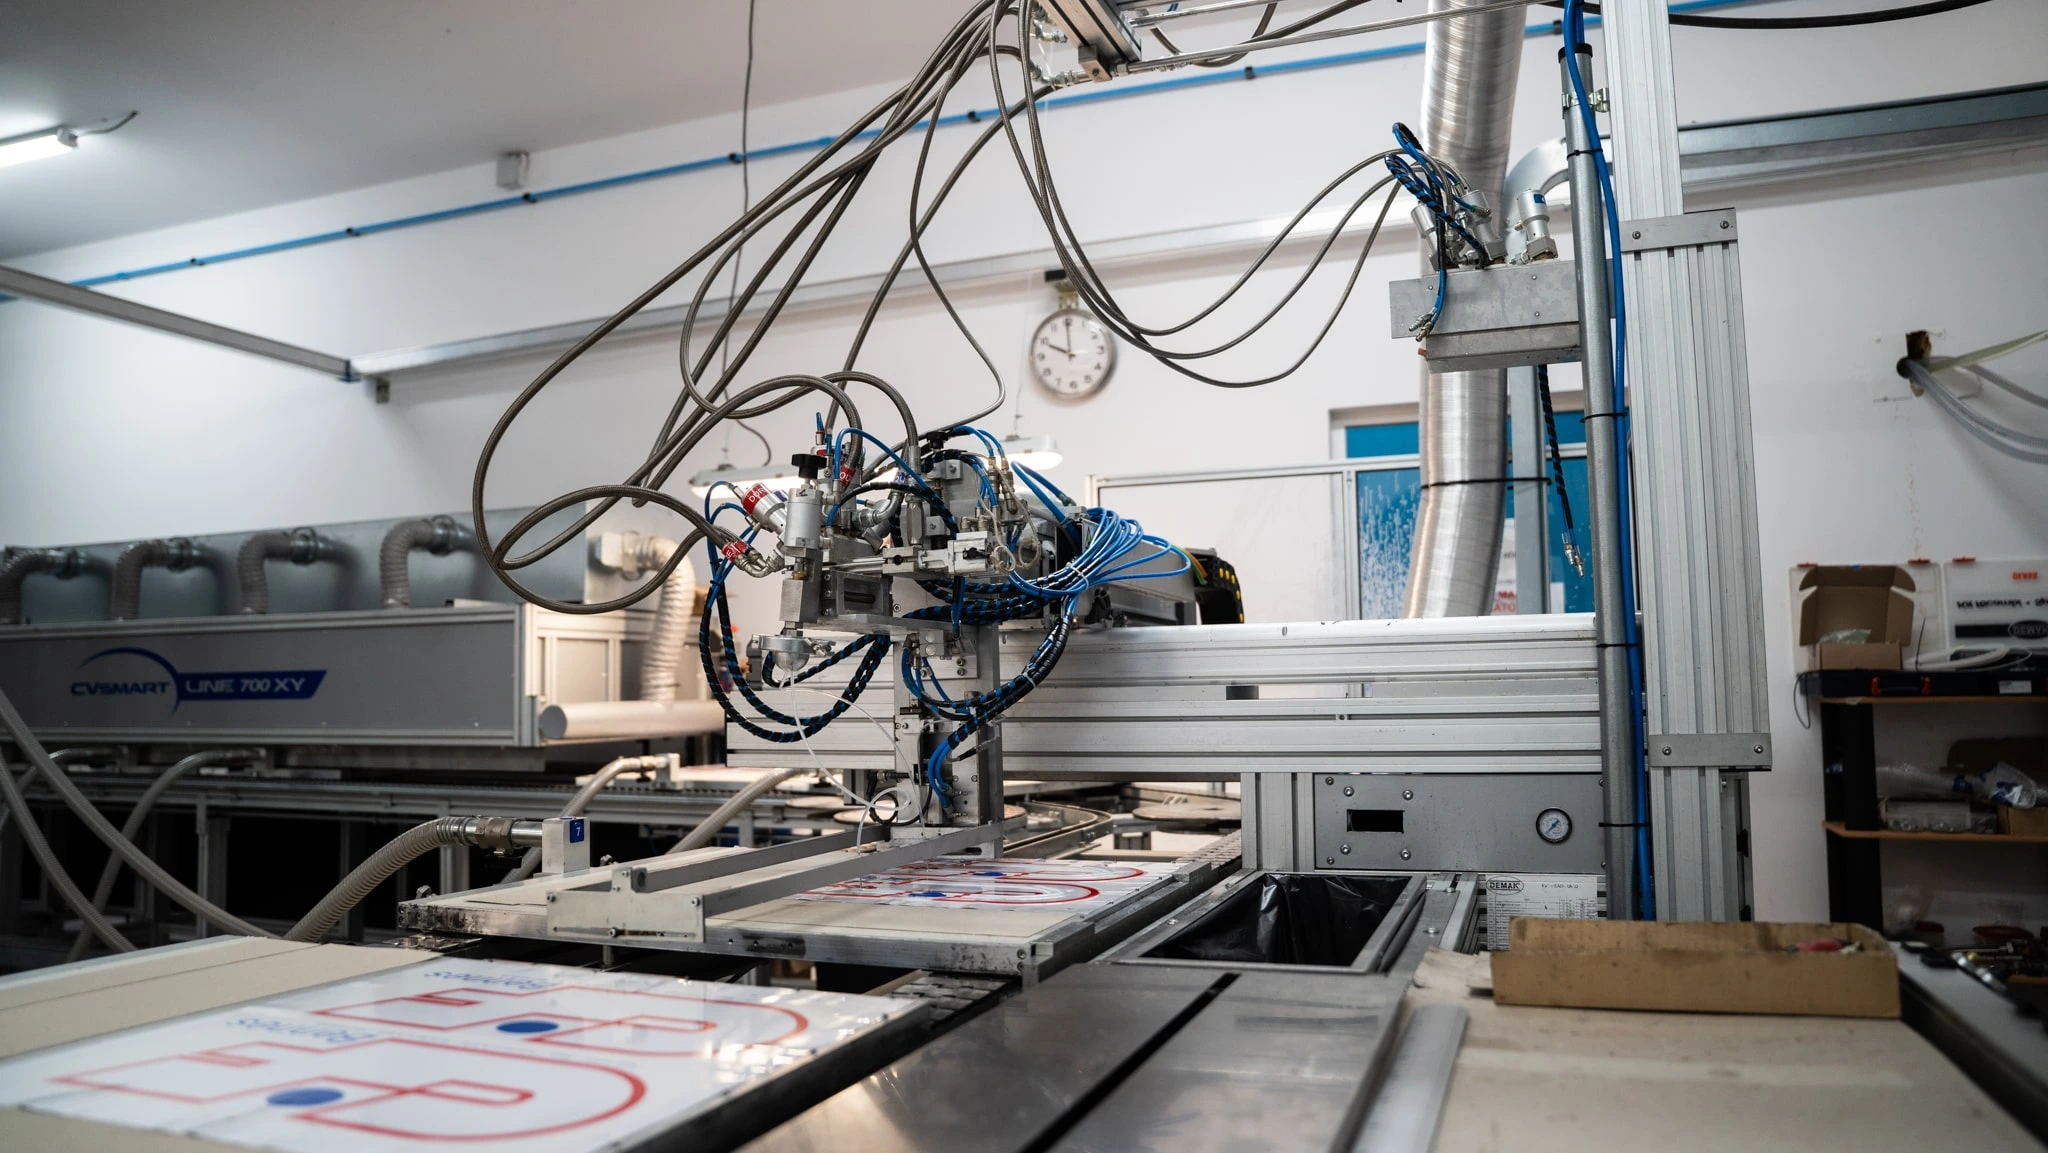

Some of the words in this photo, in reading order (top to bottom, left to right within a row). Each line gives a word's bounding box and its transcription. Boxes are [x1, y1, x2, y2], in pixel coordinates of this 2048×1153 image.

[70, 681, 170, 696] CVSMART
[186, 679, 235, 693] LINE
[240, 678, 271, 692] 700
[274, 678, 305, 692] XY
[575, 826, 581, 837] 7
